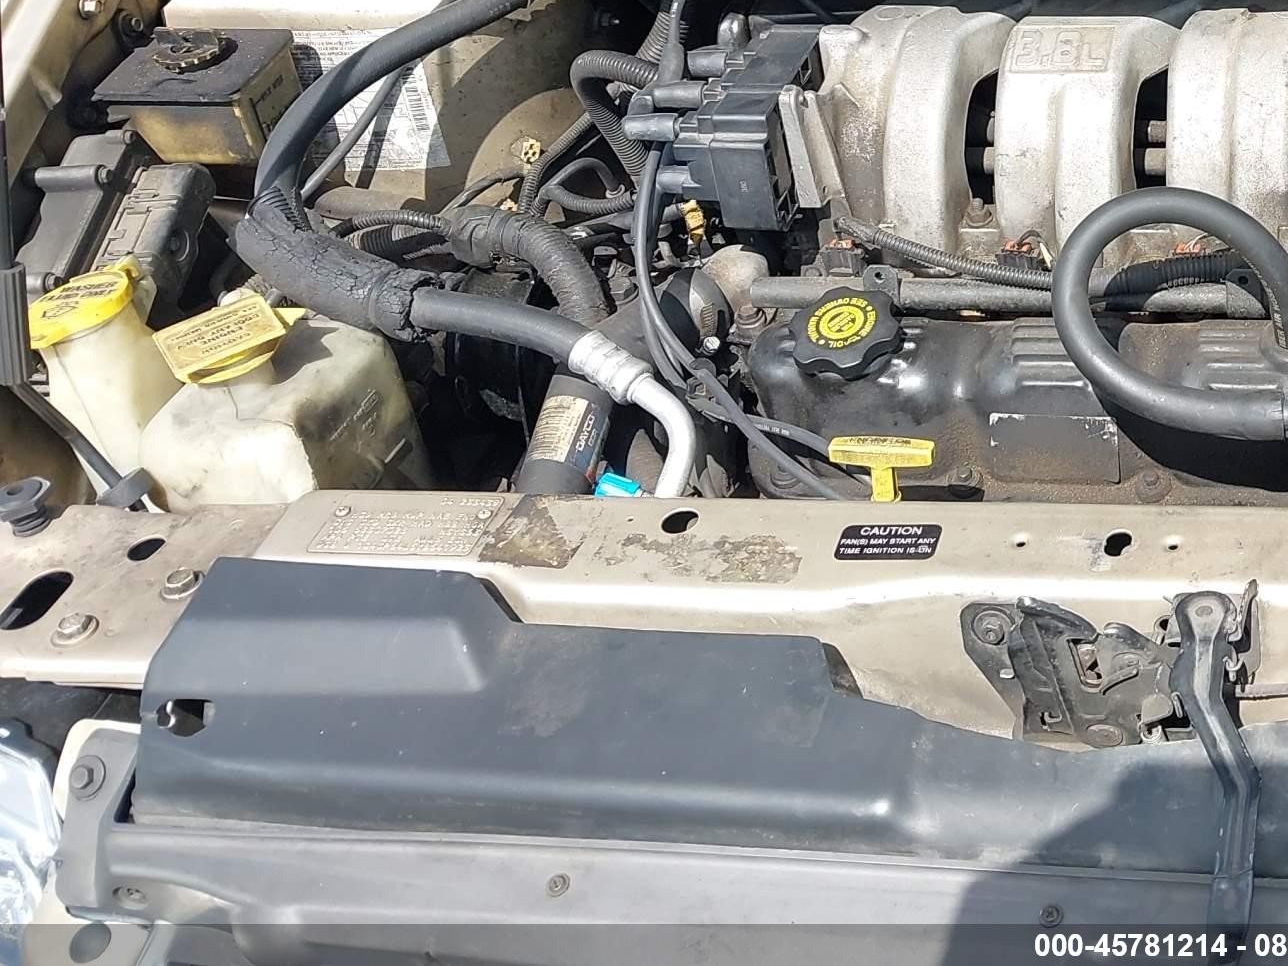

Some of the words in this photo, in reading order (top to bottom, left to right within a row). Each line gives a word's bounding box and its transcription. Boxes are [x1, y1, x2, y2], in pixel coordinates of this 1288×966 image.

[850, 297, 869, 308] SEE
[1274, 313, 1284, 327] AIR
[828, 340, 844, 349] OIL
[575, 413, 596, 452] DAYCO
[860, 526, 923, 536] CAUTION
[840, 538, 868, 546] FAN(S)
